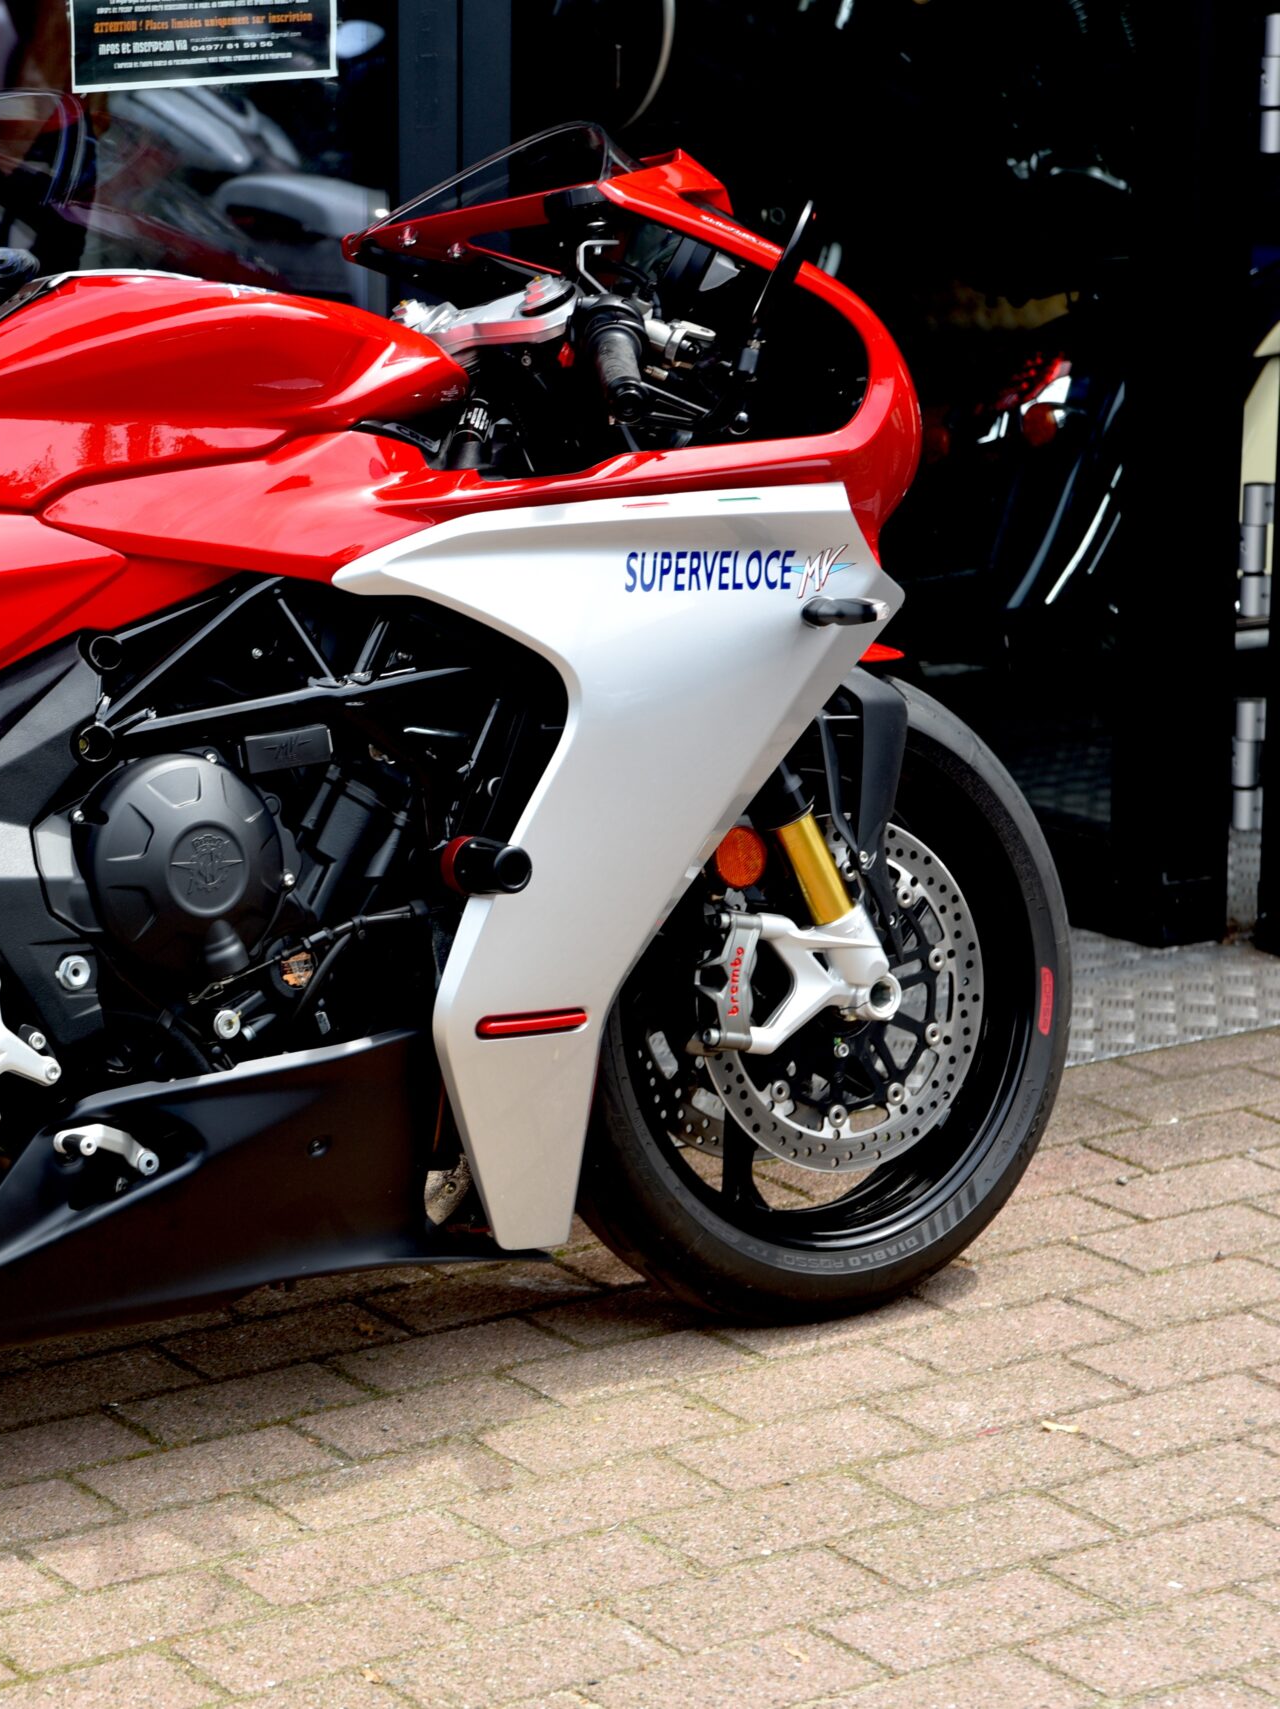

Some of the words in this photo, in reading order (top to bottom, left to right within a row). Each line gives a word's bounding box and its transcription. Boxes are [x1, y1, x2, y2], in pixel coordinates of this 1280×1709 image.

[145, 19, 169, 31] Places
[171, 17, 203, 29] limitées
[204, 15, 249, 28] uniquement
[252, 15, 266, 25] sur
[268, 11, 313, 24] inscription
[191, 43, 223, 52] 0497/
[243, 41, 257, 49] 59
[260, 40, 274, 48] 56
[624, 549, 797, 593] SUPERVELOCE
[797, 543, 849, 599] MV
[727, 946, 745, 1017] brembo
[783, 1253, 845, 1270] ROSSO
[848, 1235, 920, 1267] DIABLO
